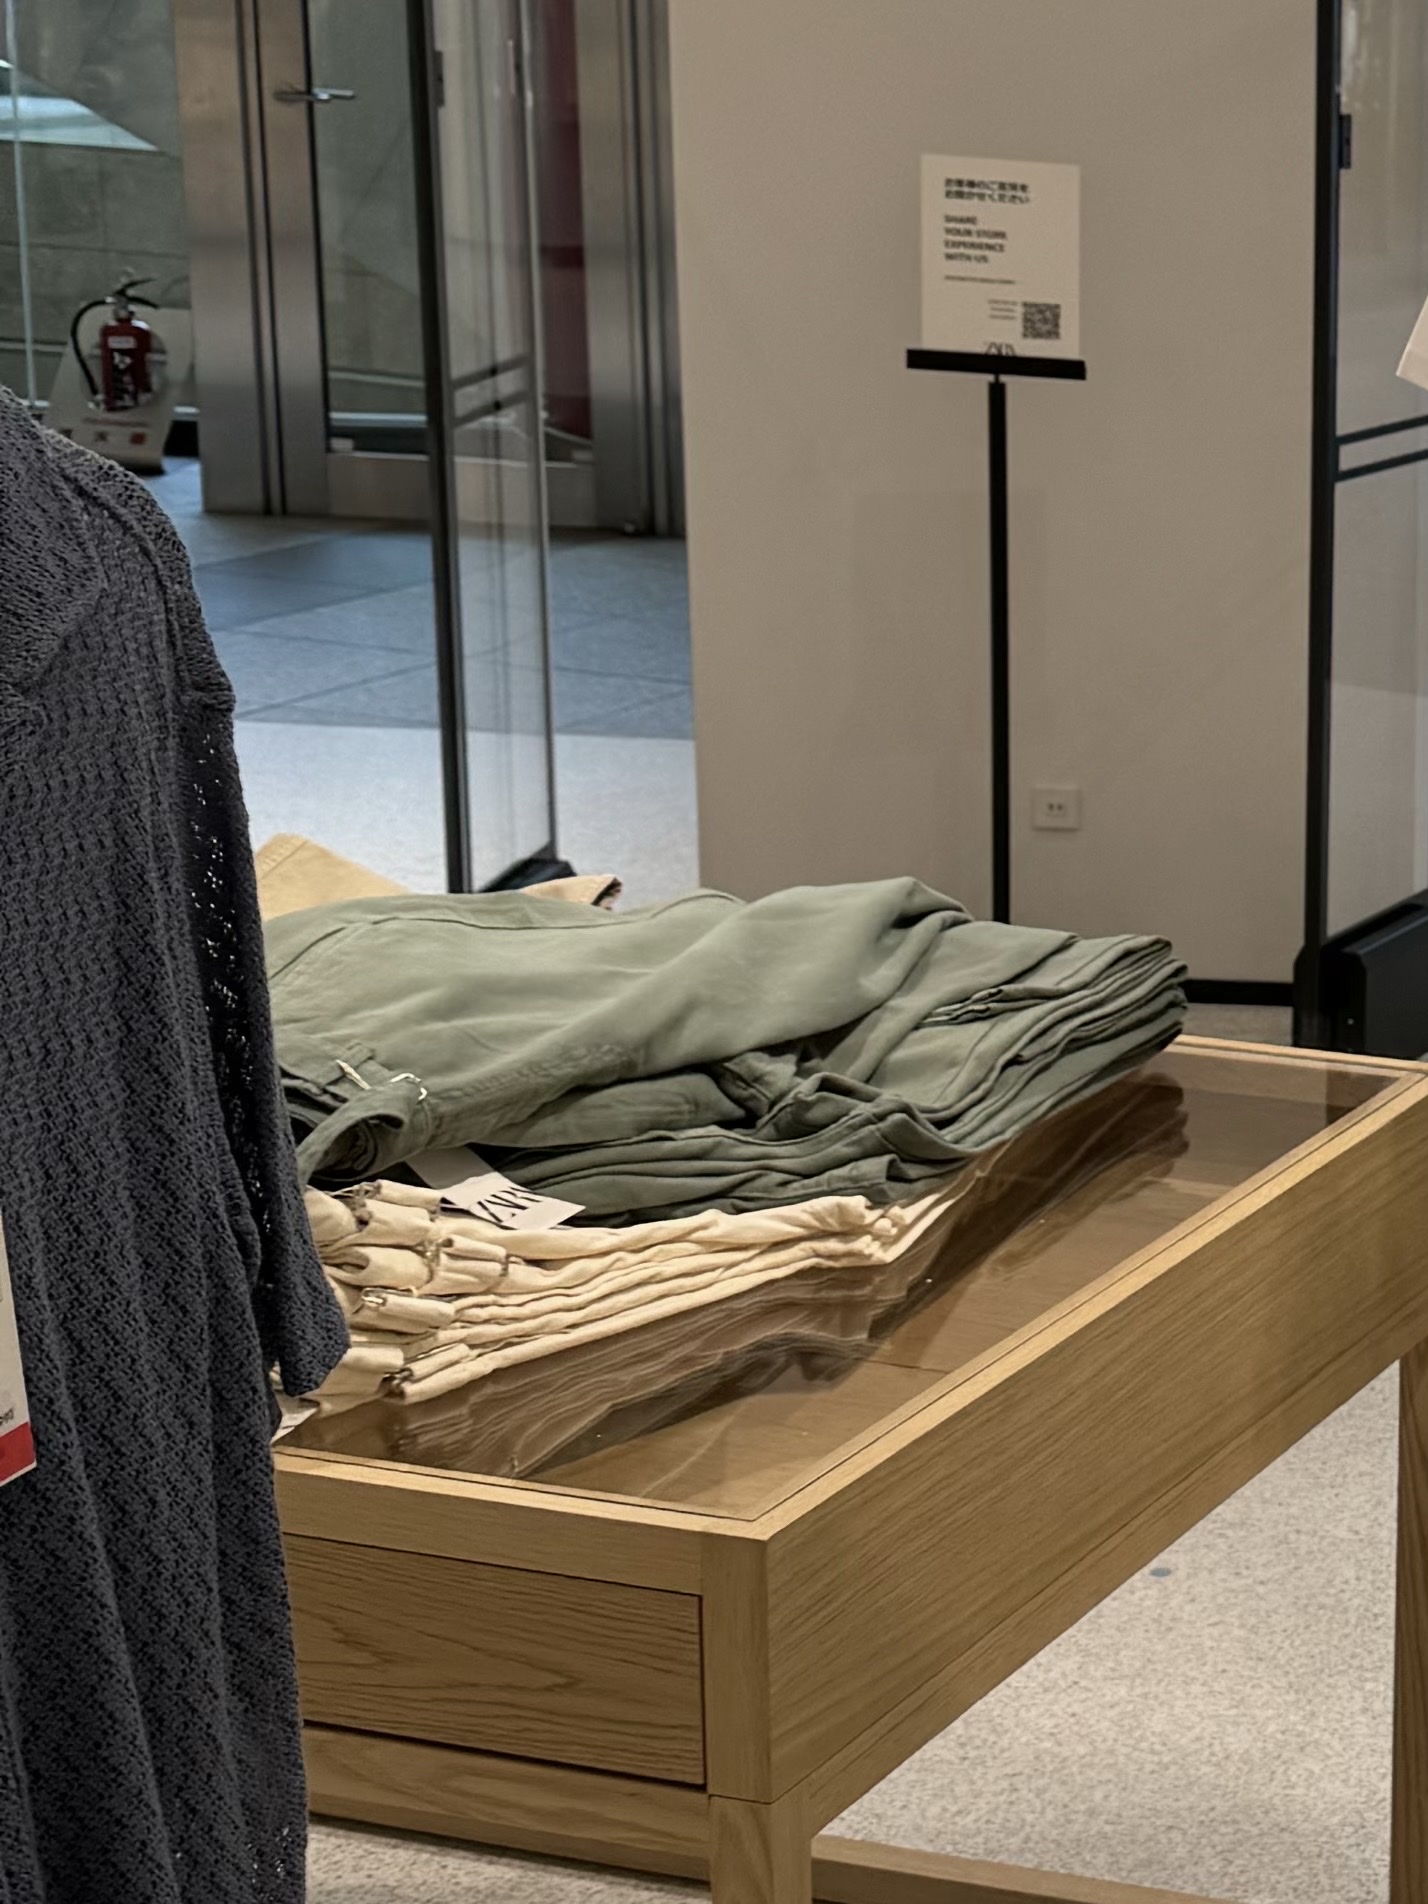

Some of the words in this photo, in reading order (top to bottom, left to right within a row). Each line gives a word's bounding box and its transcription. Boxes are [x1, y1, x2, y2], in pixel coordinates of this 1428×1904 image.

[944, 214, 977, 226] SHARE
[944, 227, 973, 238] YOUR
[944, 240, 1006, 253] EXPERIENCE
